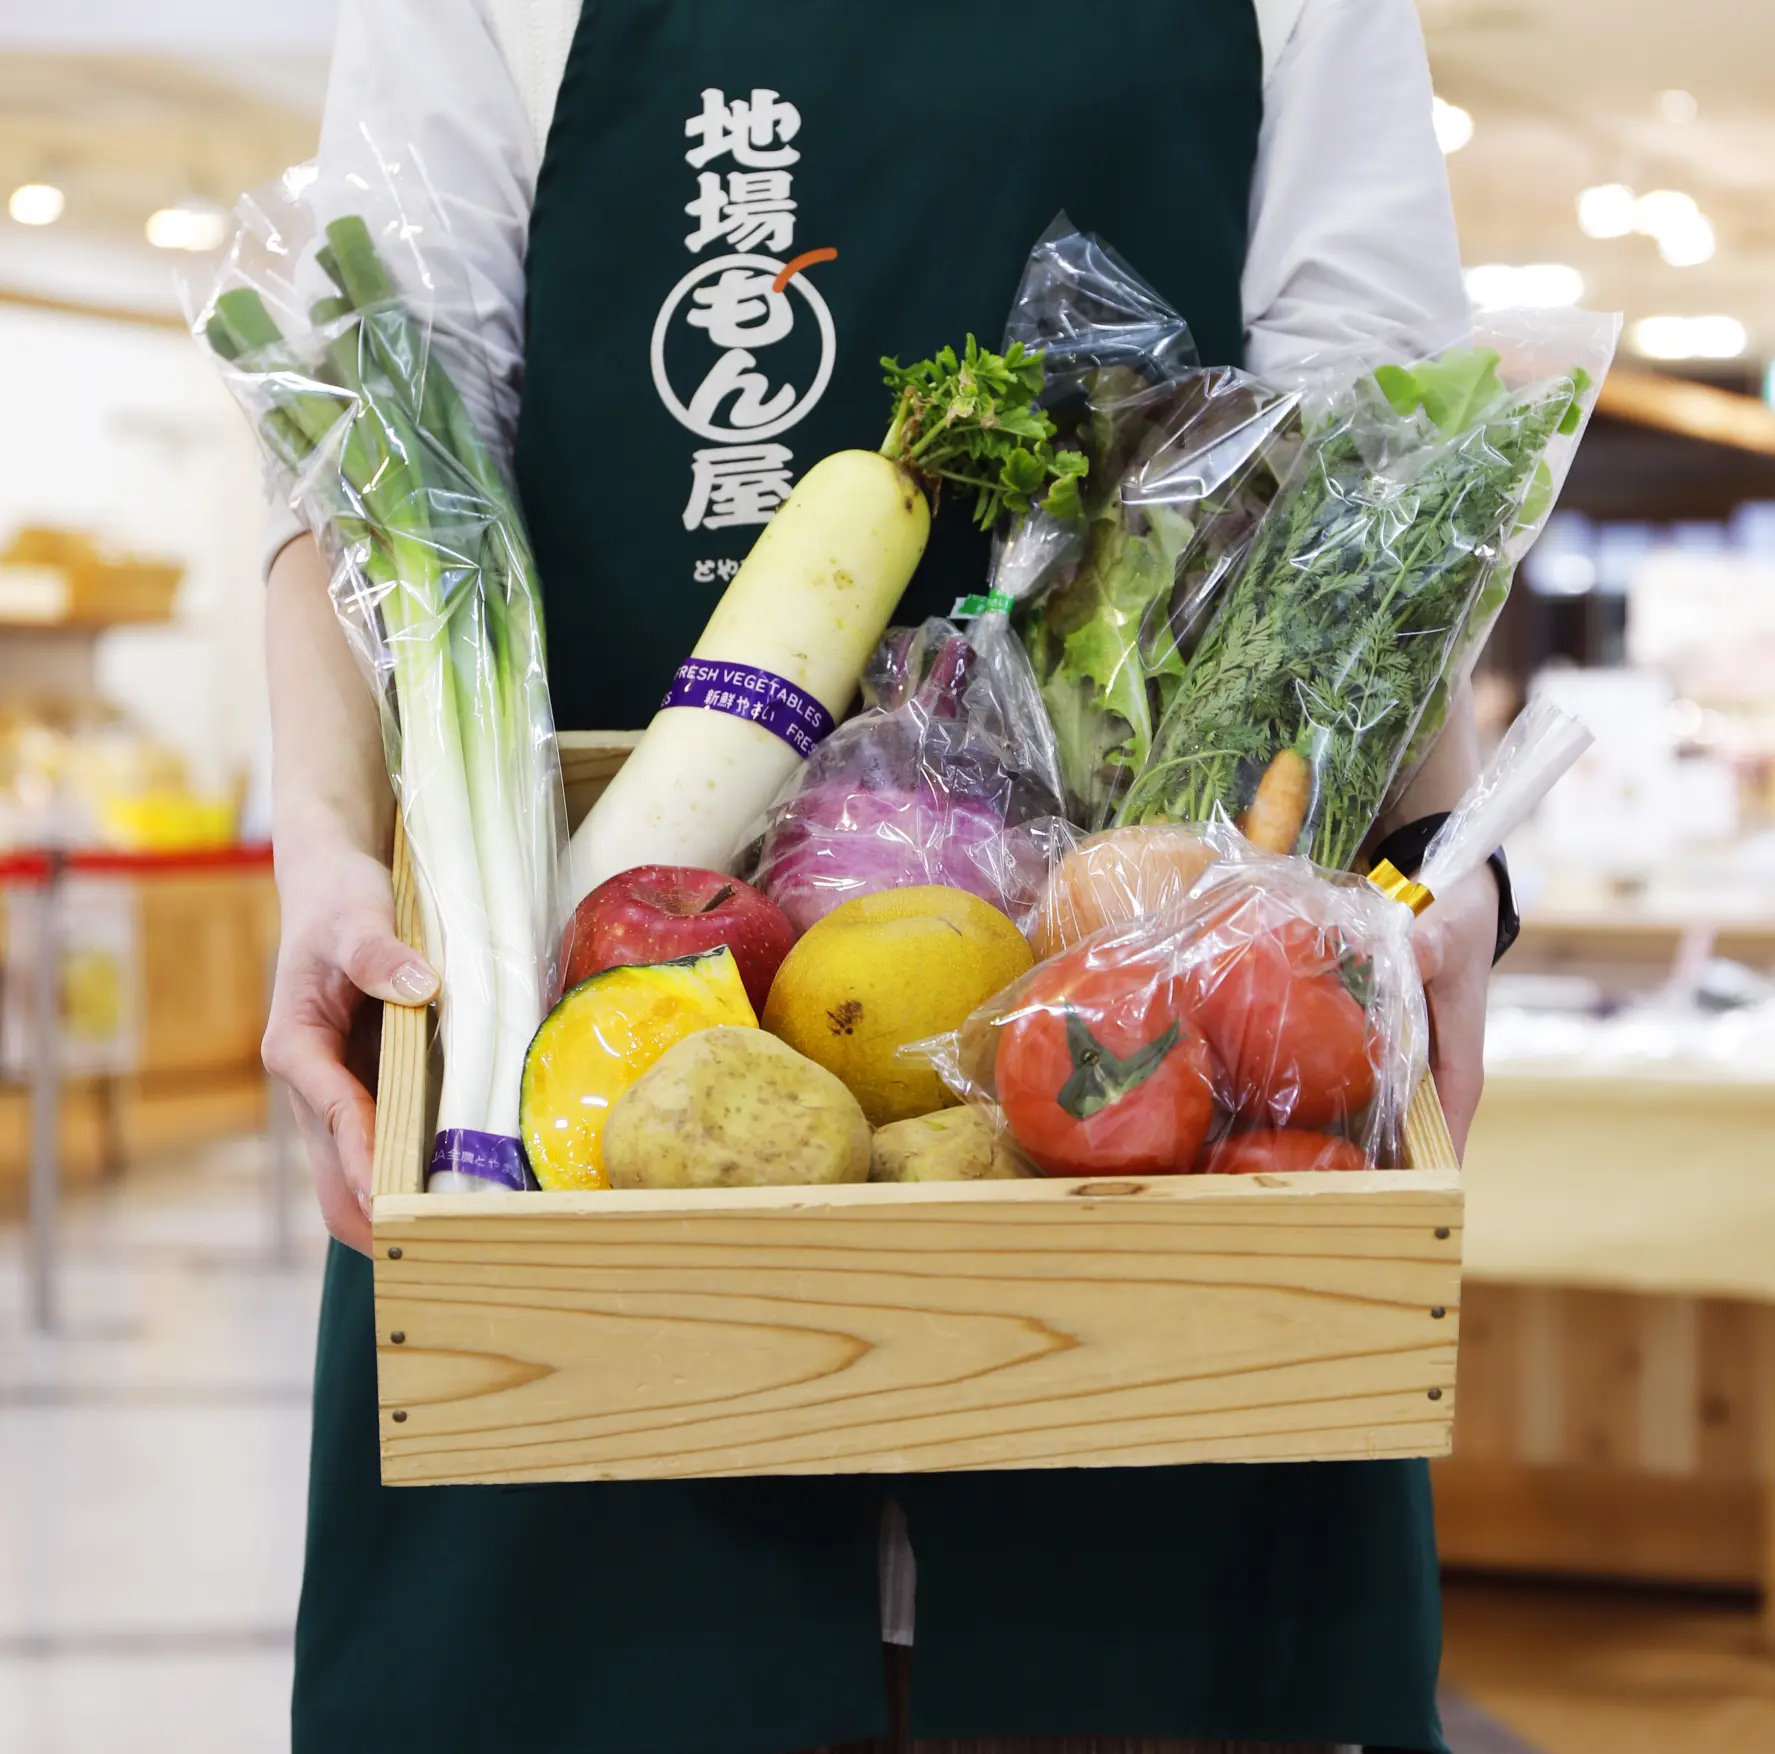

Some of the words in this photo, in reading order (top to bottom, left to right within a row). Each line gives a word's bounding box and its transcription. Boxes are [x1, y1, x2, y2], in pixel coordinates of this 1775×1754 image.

[683, 87, 802, 532] 地場もん屋
[693, 558, 744, 583] とや
[674, 664, 719, 682] FRESH
[723, 669, 822, 728] VEGETABLES
